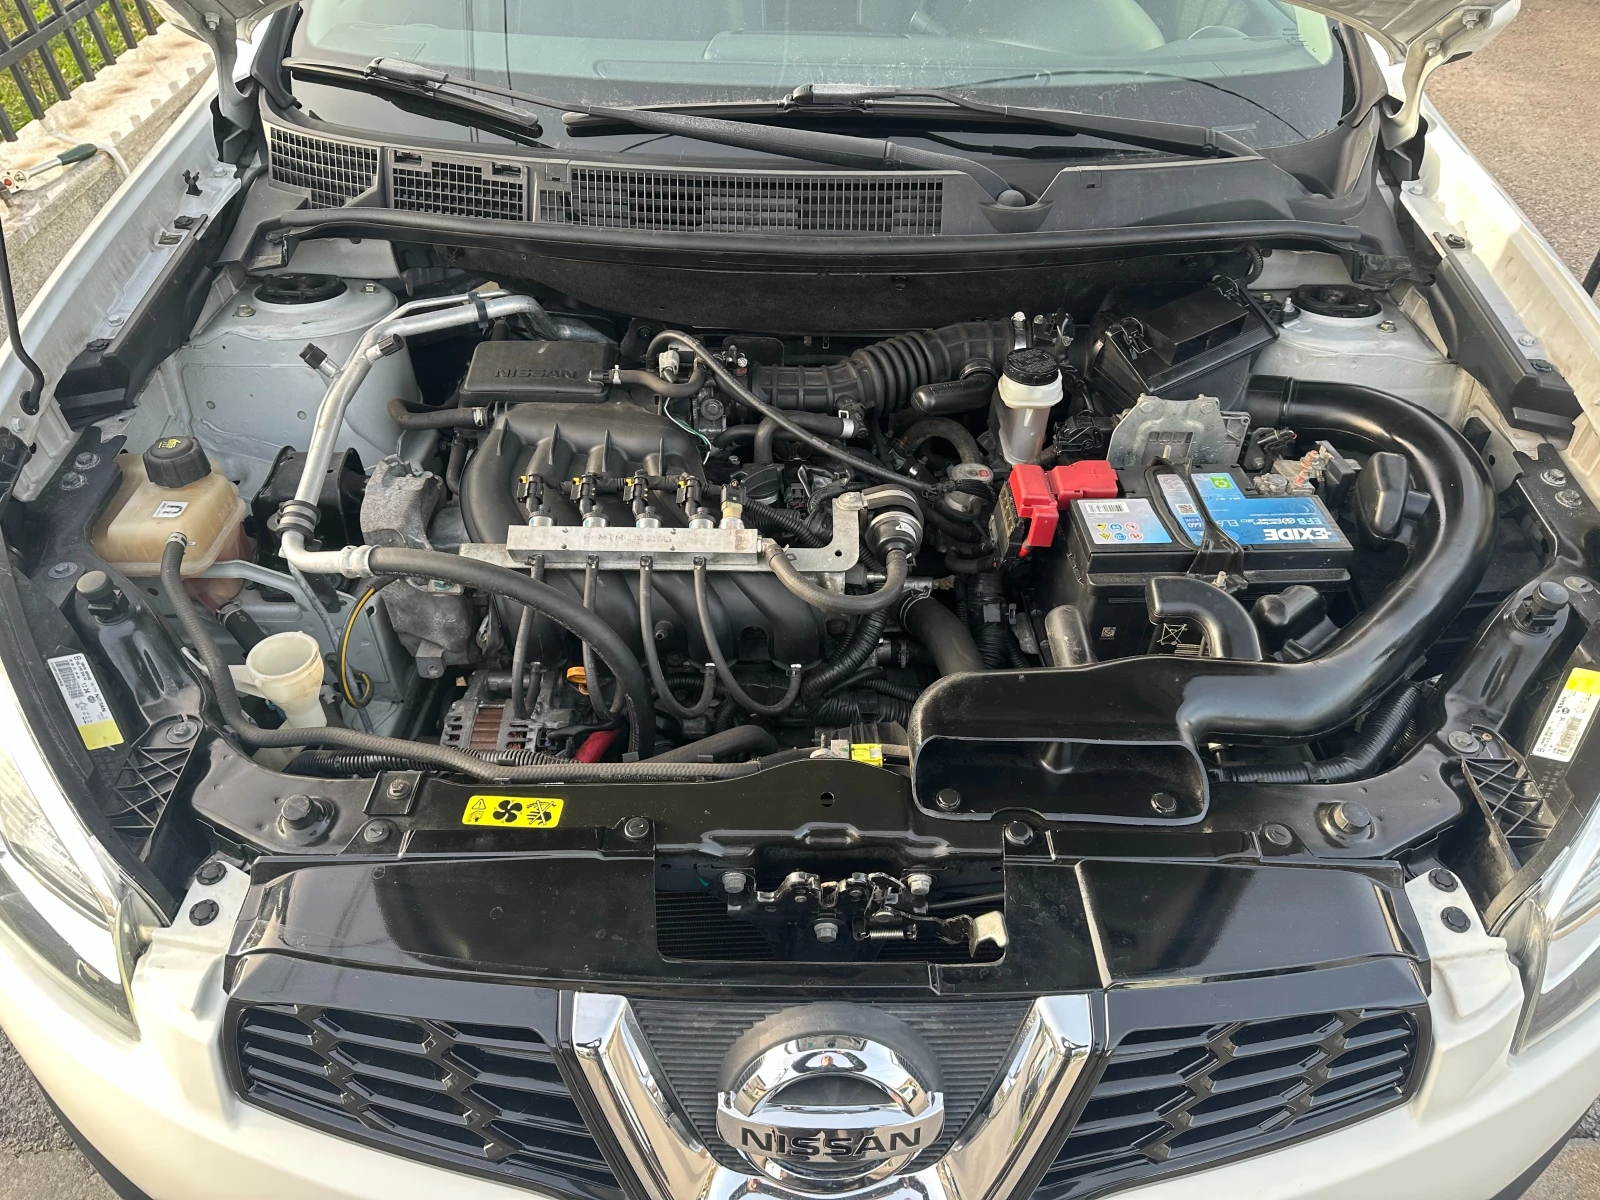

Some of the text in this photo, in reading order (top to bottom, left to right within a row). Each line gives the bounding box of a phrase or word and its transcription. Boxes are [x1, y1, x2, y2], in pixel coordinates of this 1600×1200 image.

[494, 369, 577, 379] NISSAN
[1263, 528, 1331, 541] EXIDE
[741, 1127, 921, 1157] NISSAN
